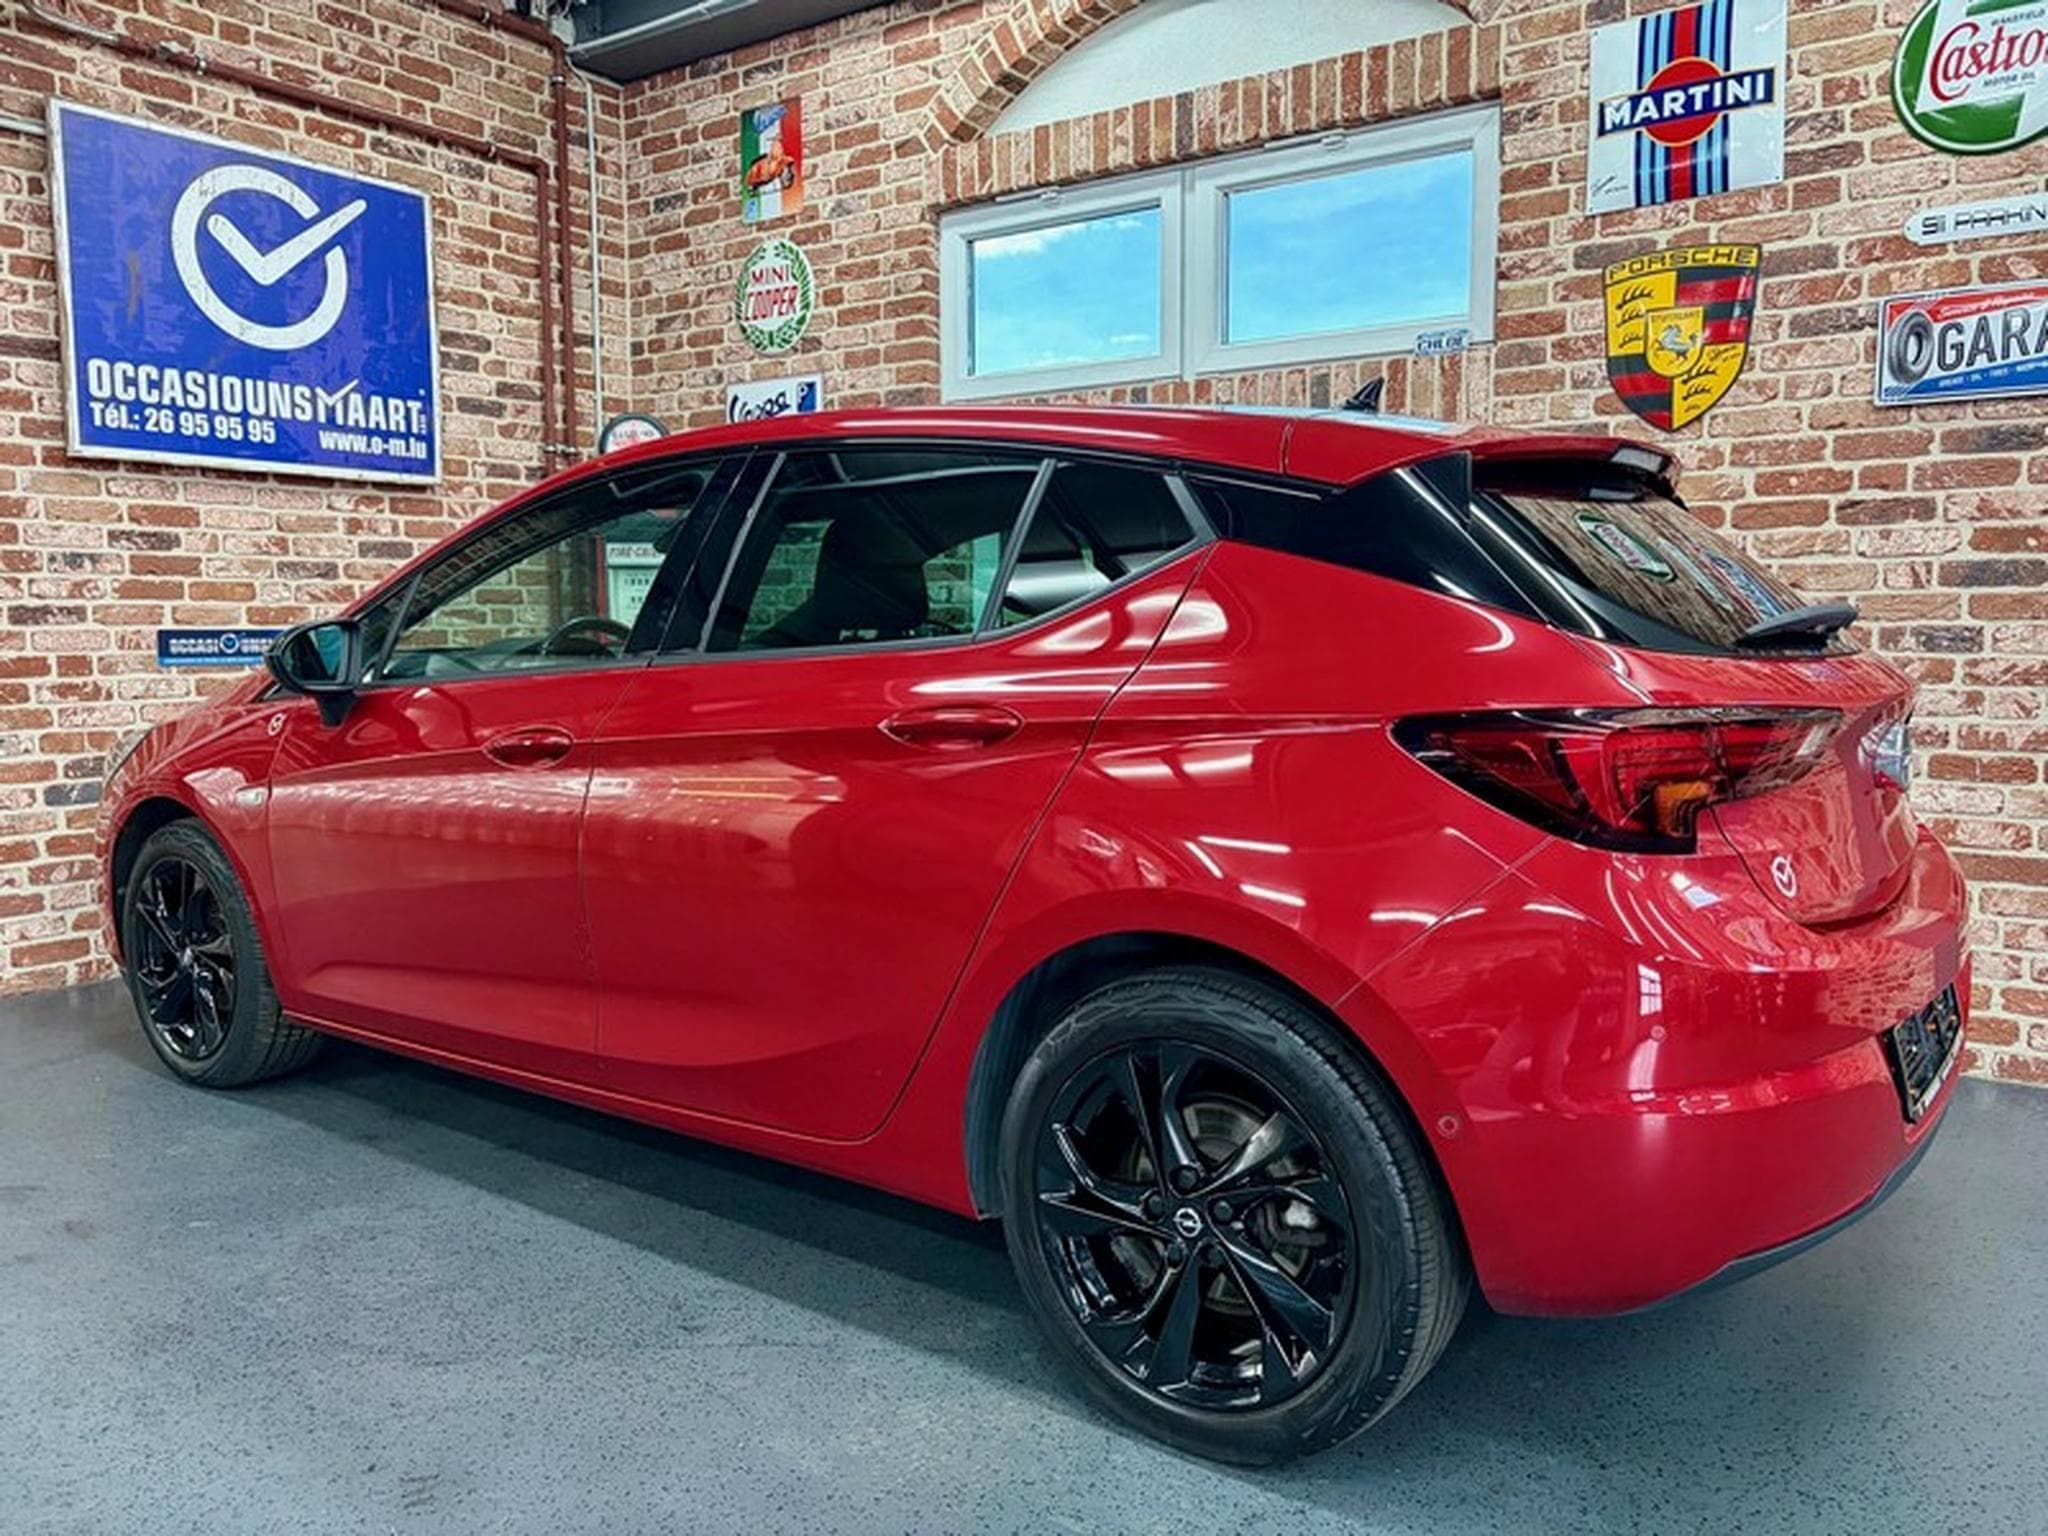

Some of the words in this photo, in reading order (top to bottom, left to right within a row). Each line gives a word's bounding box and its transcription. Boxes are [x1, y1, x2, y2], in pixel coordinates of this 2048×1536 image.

[1929, 21, 2048, 102] Castro
[1604, 73, 1766, 131] MARTINI
[751, 264, 790, 286] MINI
[1608, 247, 1756, 281] PORSCHE
[743, 286, 798, 321] COOPER
[87, 357, 423, 434] OCCASIOUNSMAART
[143, 407, 175, 434] 26
[178, 410, 210, 437] 95
[213, 415, 244, 441] 95
[247, 418, 277, 444] 95
[318, 429, 428, 459] www.o-m.lu
